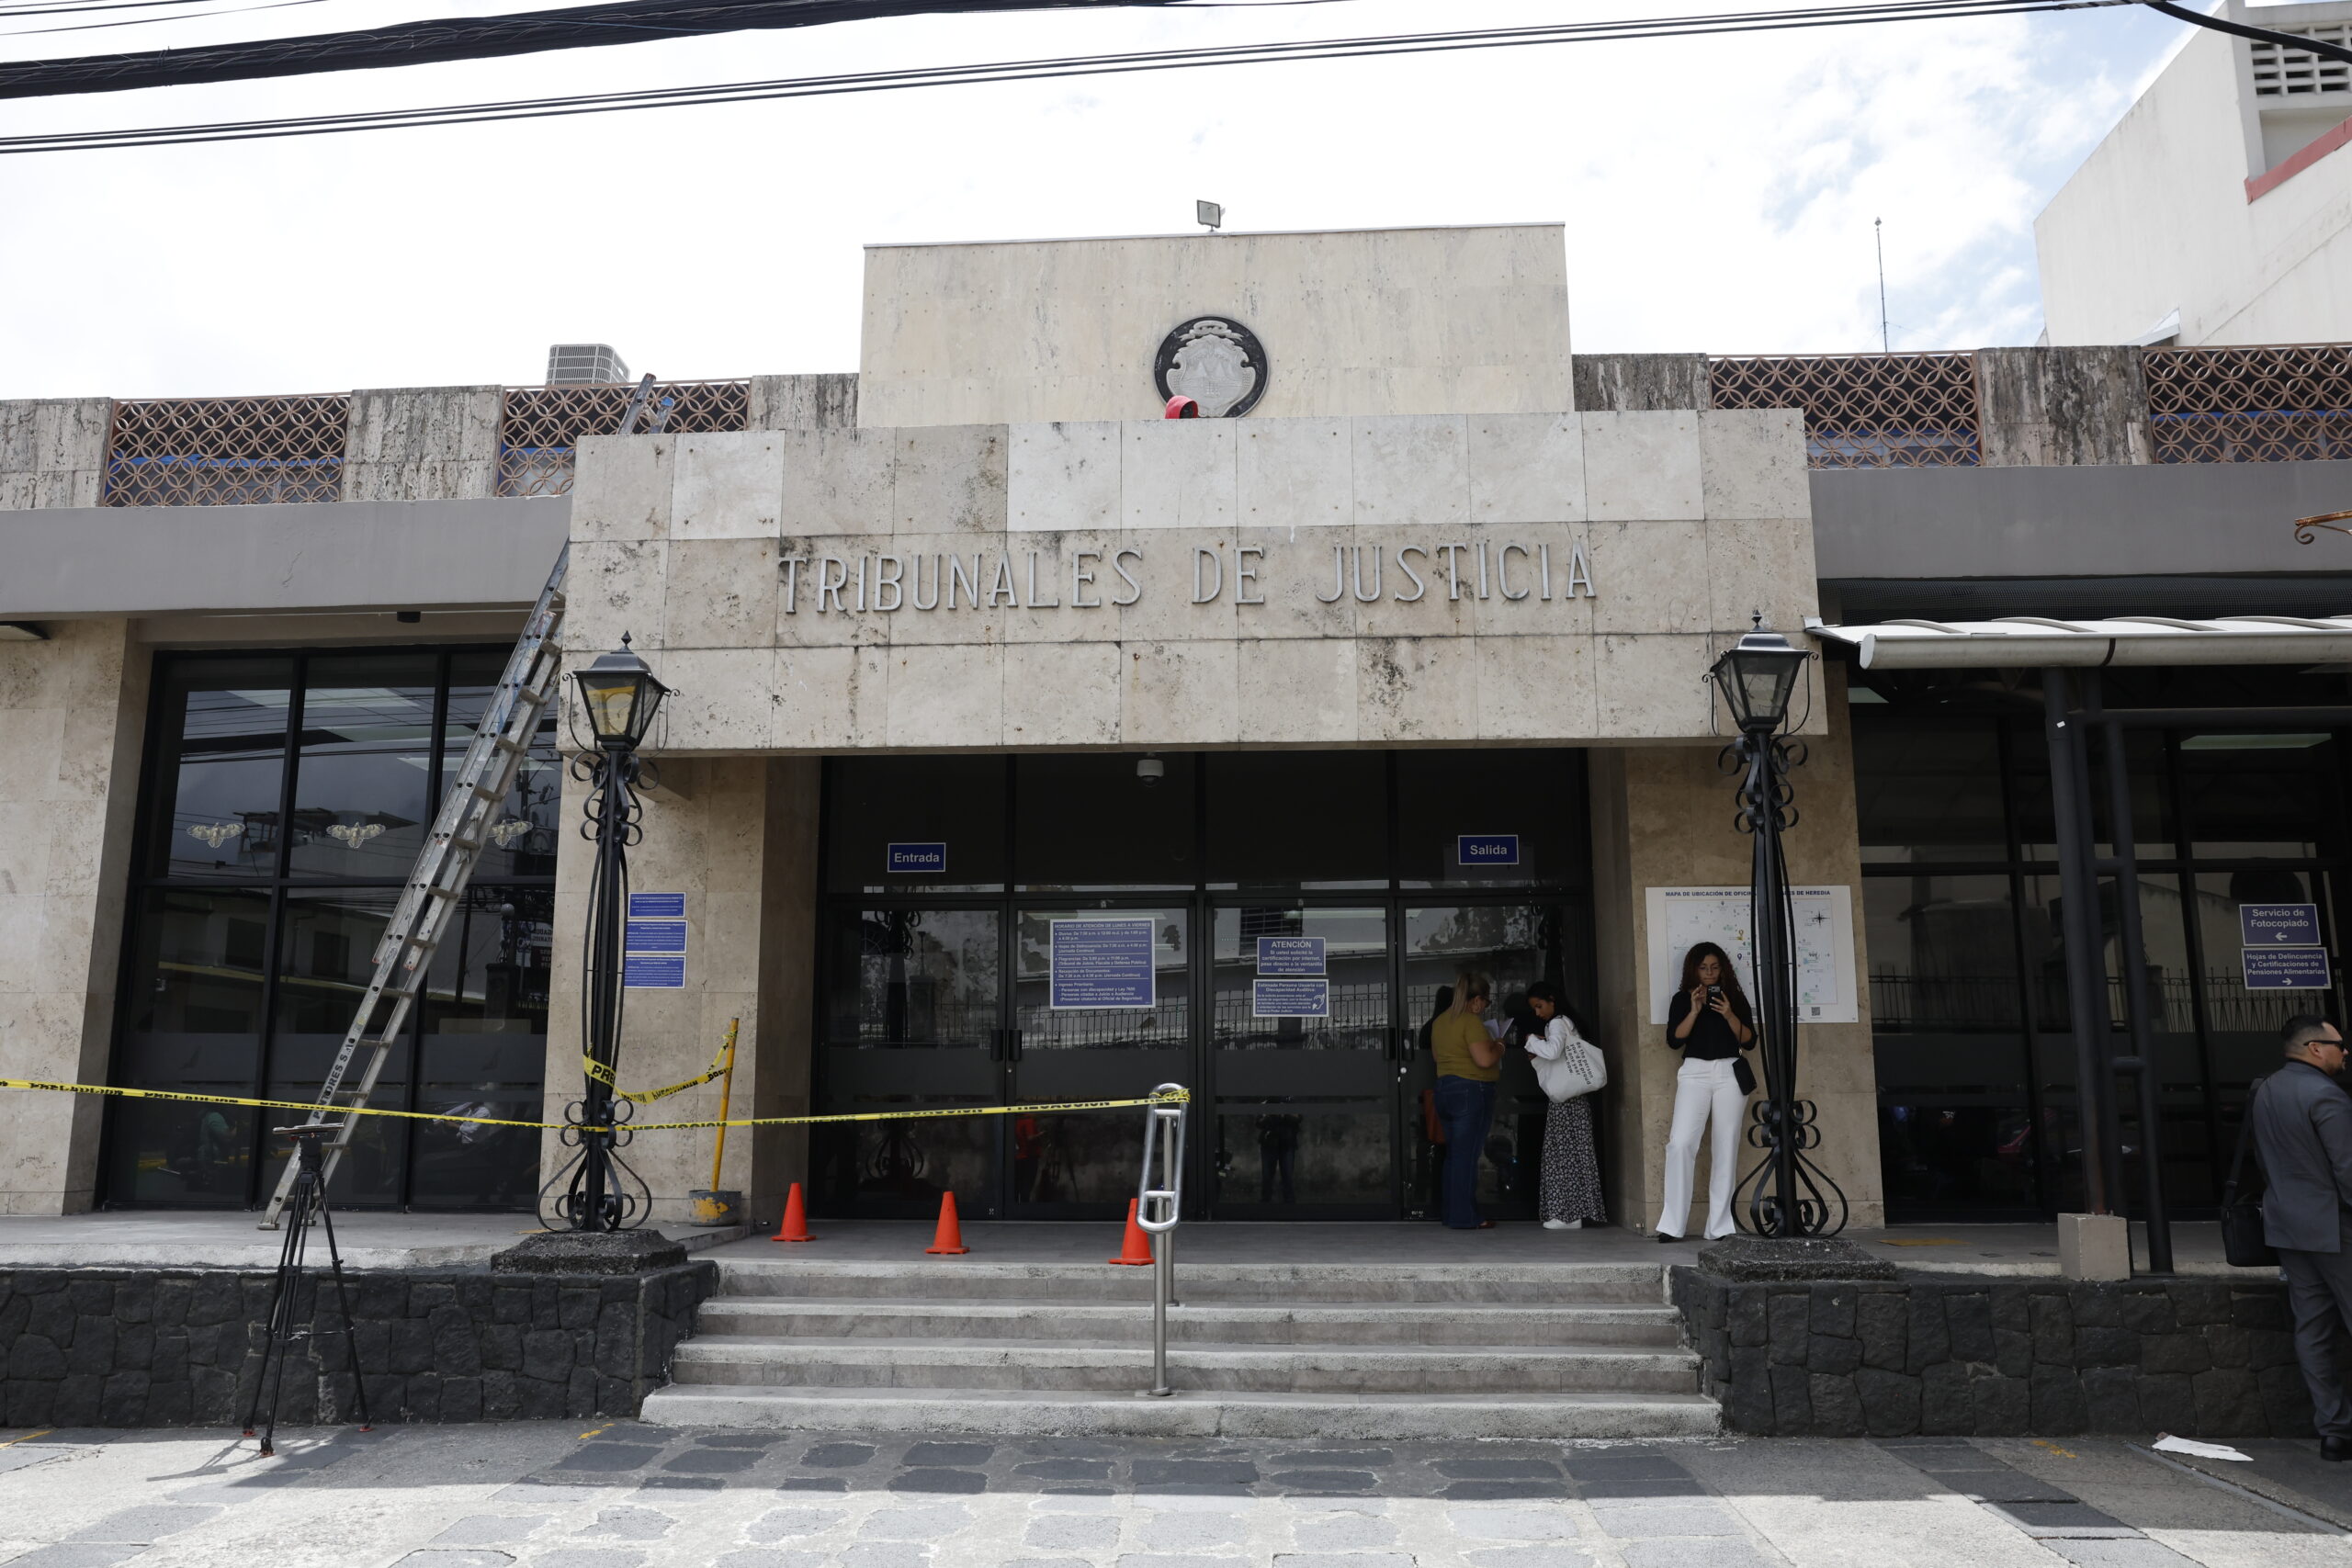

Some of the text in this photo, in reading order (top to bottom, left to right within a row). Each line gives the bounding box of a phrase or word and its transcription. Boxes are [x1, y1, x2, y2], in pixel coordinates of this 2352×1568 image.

[778, 541, 1598, 615] TRIBUNALES DE JUSTICIA
[1470, 845, 1507, 855] Salida
[894, 852, 940, 863] Entrada
[2250, 919, 2309, 928] Fotocopiado
[1271, 940, 1311, 948] ATENCIÓN
